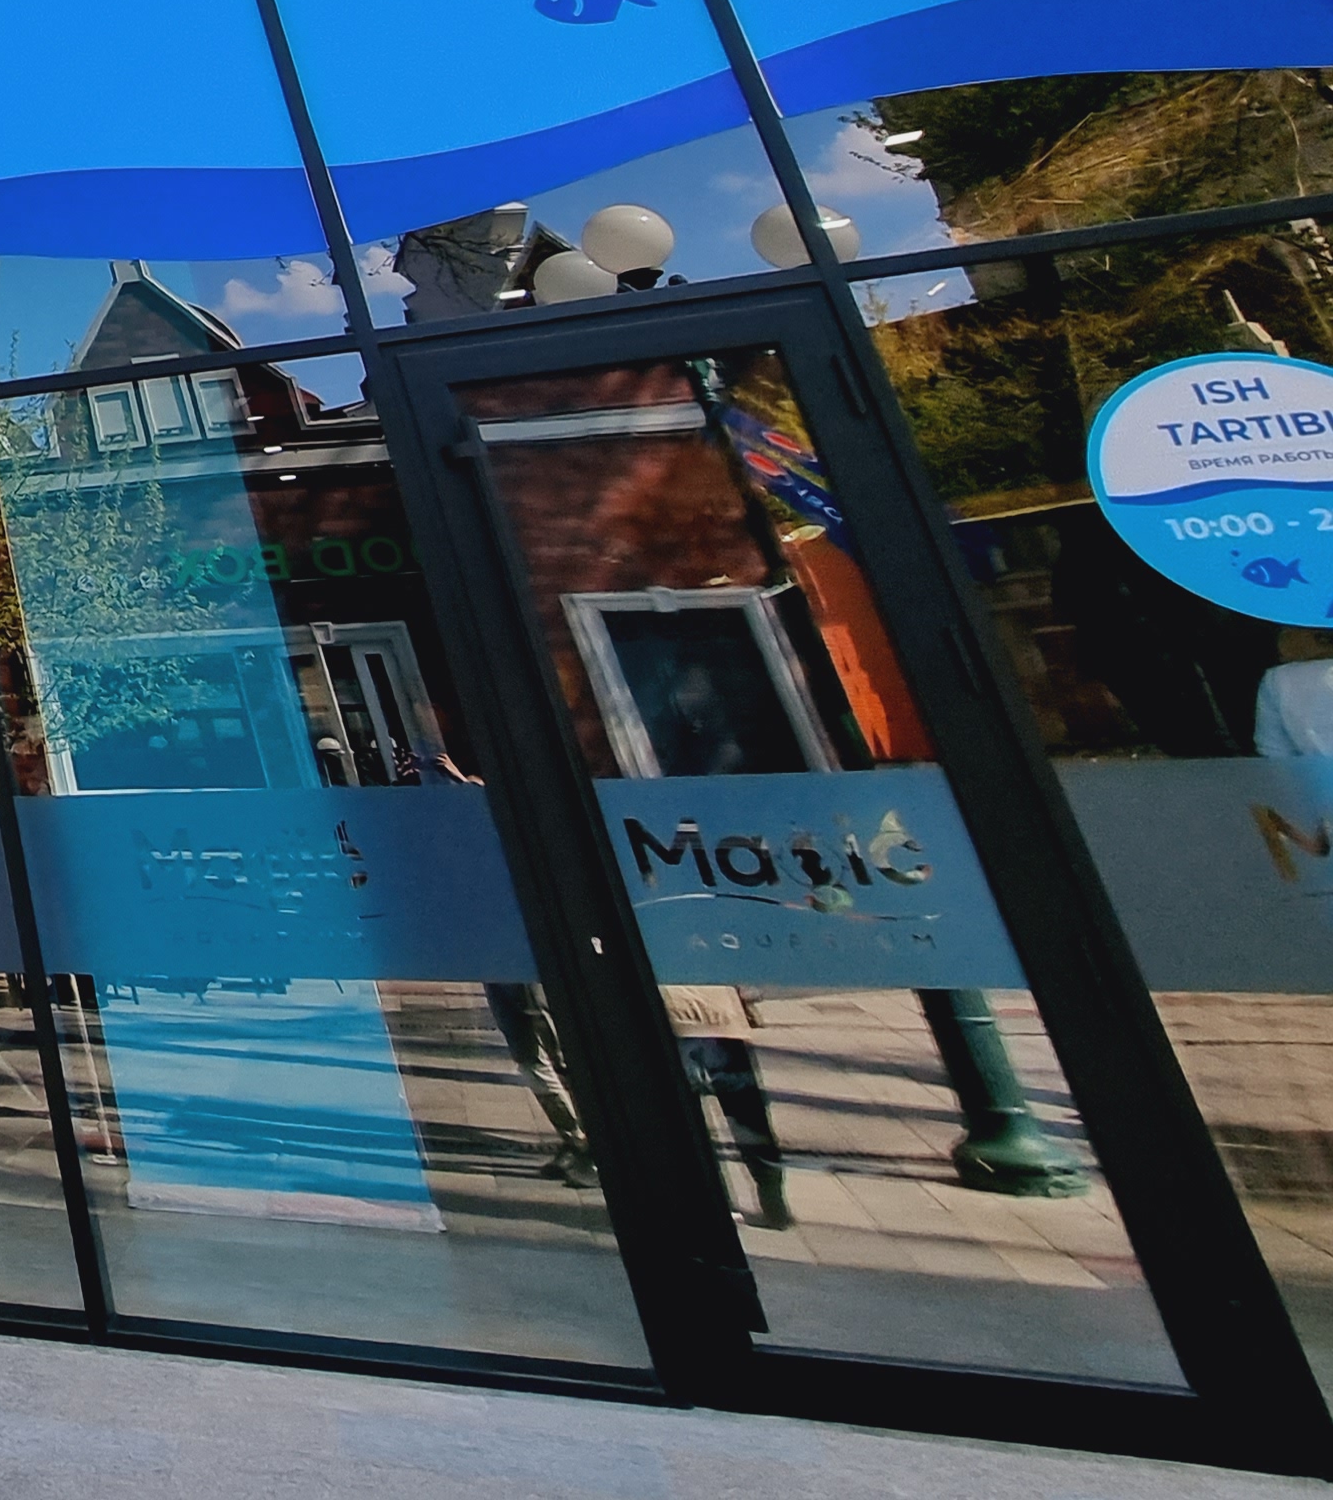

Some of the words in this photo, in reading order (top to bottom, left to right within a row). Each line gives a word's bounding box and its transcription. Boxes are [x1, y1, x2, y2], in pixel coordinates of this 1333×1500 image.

[1191, 377, 1271, 406] ISH
[1188, 456, 1254, 471] ВРЕМЯ
[1164, 512, 1275, 541] 10:00
